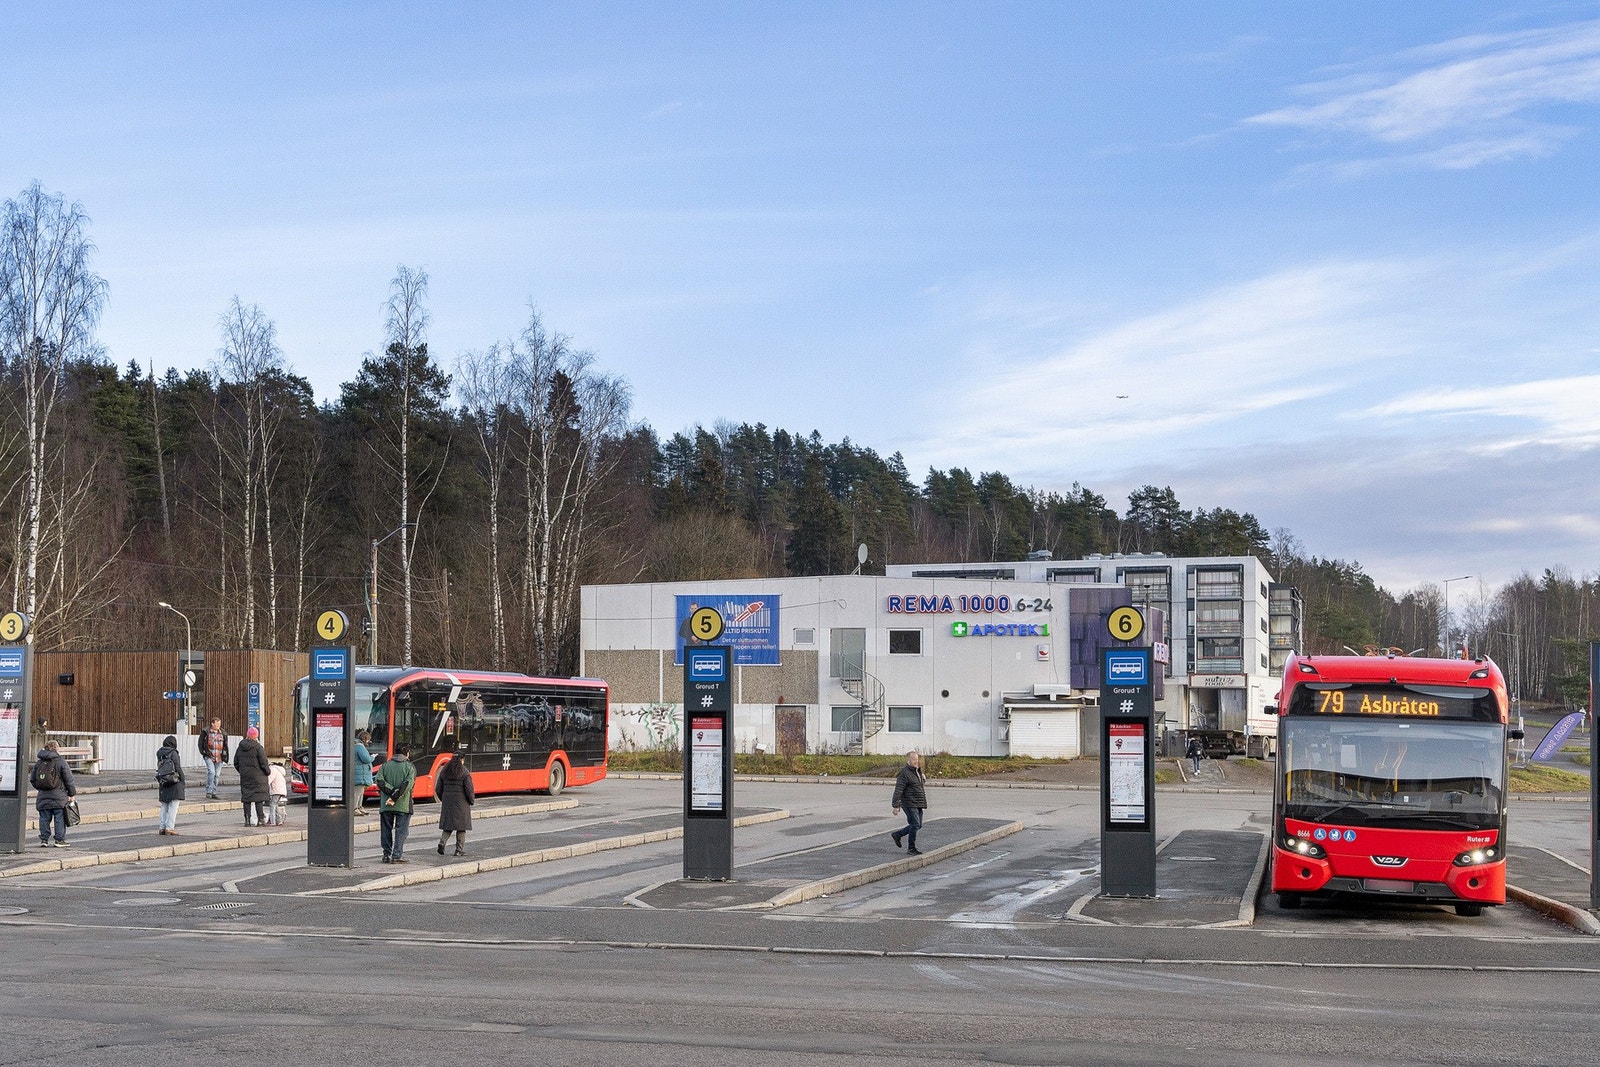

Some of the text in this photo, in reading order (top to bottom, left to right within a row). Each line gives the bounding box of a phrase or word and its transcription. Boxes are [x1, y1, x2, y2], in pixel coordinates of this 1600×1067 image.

[887, 594, 1053, 613] REMA 1000 6-24
[7, 619, 16, 635] 3
[324, 617, 335, 633] 4
[700, 616, 712, 633] 5
[971, 623, 1050, 637] APOTEK 1
[1118, 614, 1132, 633] 6
[1320, 690, 1439, 715] 79 Åsbråten
[1376, 856, 1402, 864] VDL
